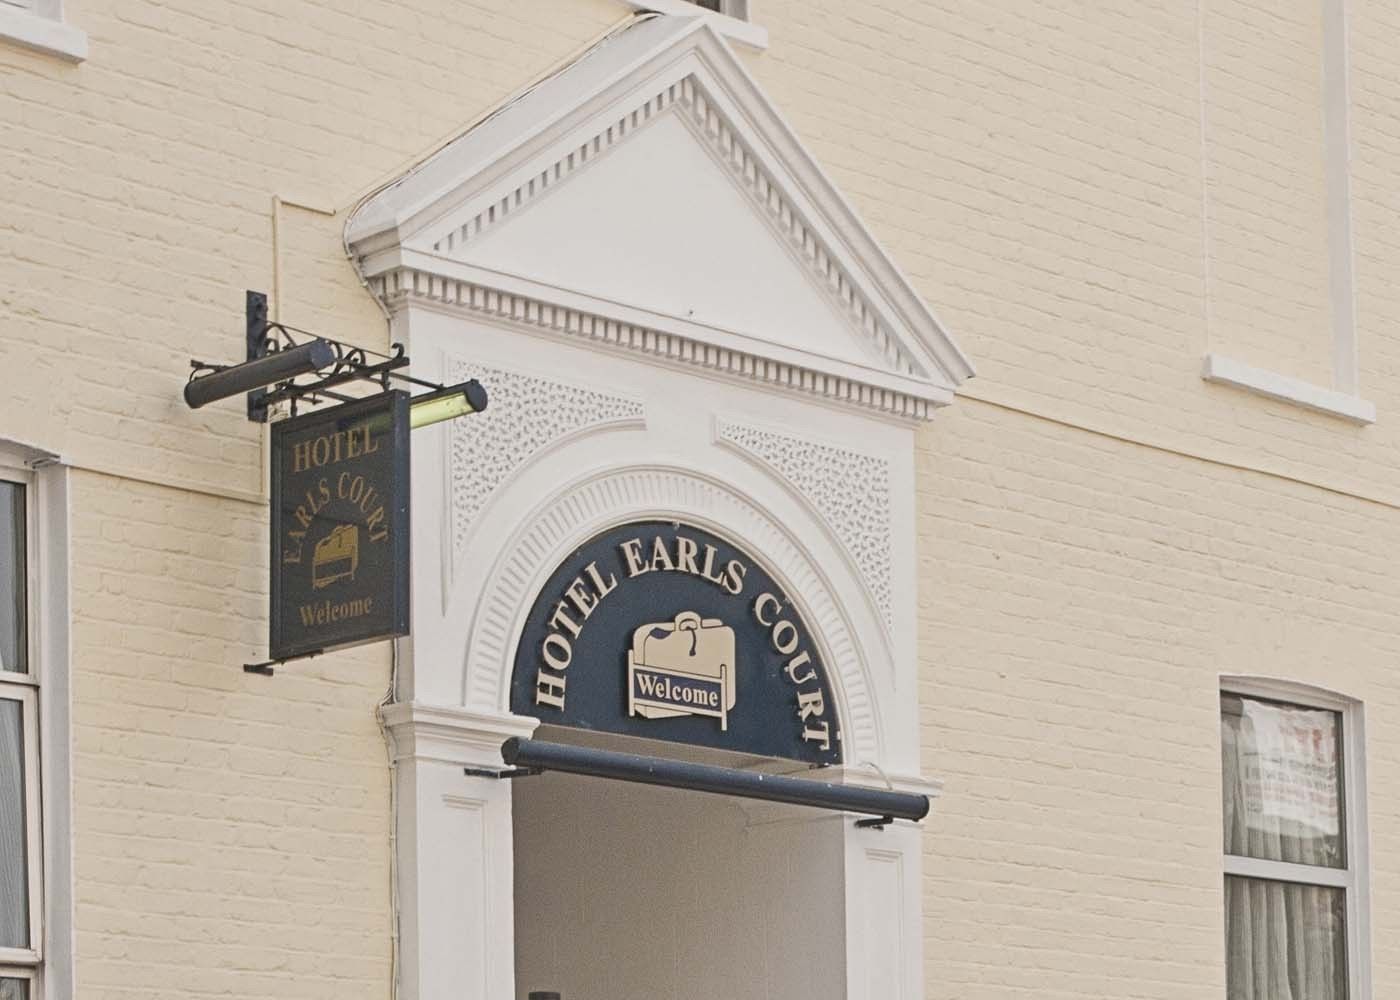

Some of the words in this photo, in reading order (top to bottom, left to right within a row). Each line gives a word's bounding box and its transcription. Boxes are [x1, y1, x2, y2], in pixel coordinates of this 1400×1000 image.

[293, 424, 378, 473] HOTEL
[284, 478, 330, 564] EARLS
[338, 472, 389, 544] COURT
[300, 597, 372, 626] Welcome
[535, 561, 618, 712] HOTEL
[620, 536, 747, 596] EARLS
[753, 593, 830, 751] COURT
[636, 672, 719, 707] Welcome
